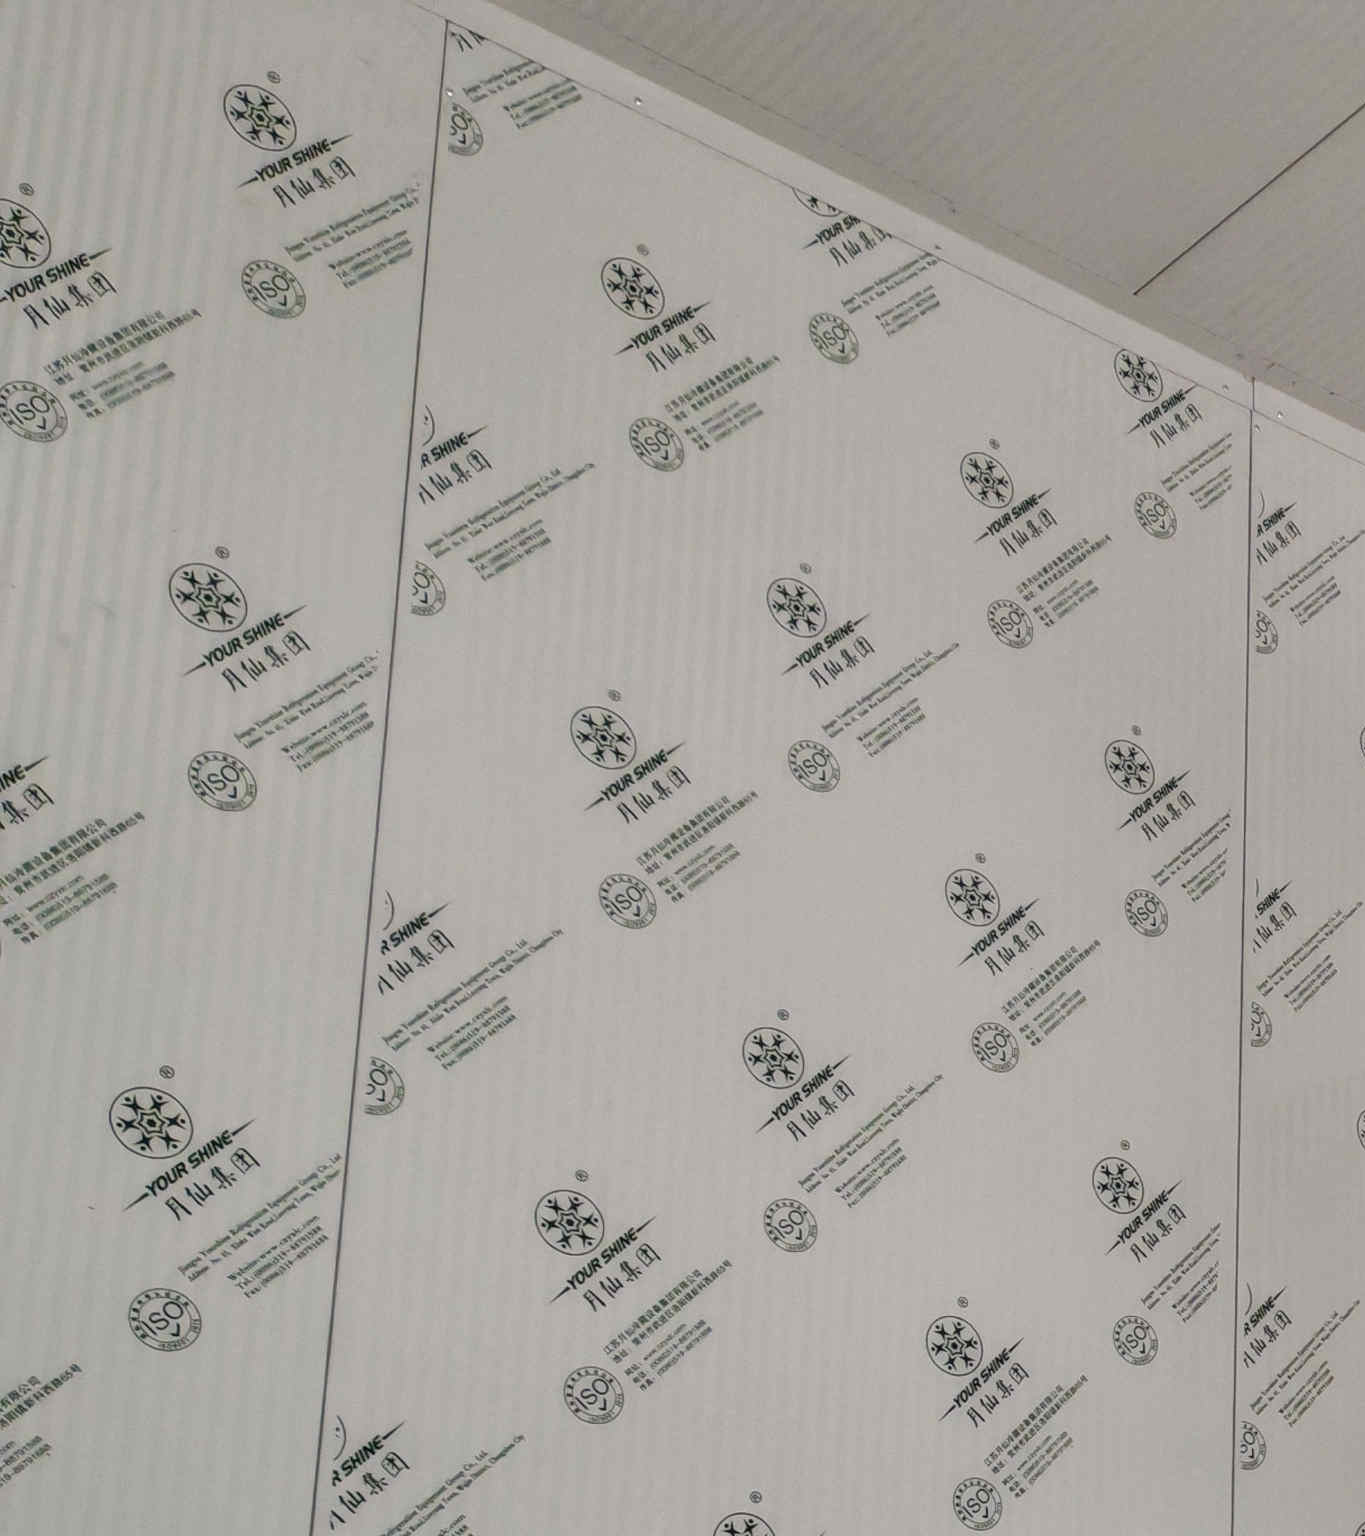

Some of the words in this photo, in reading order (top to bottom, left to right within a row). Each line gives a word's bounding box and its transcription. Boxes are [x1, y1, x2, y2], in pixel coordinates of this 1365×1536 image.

[254, 156, 292, 181] YOUR
[291, 139, 334, 165] SHINE
[2, 273, 45, 300] YOUR
[45, 253, 93, 282] SHINE
[249, 271, 293, 301] ISO
[630, 325, 662, 348] YOUR
[661, 307, 696, 332] SHINE
[5, 392, 54, 424] ISO
[1138, 406, 1162, 427] YOUR
[1160, 389, 1186, 412] SHINE
[430, 432, 470, 461] SHINE
[637, 428, 673, 455] ISO
[986, 512, 1012, 535] YOUR
[1011, 494, 1040, 519] SHINE
[1140, 501, 1167, 525] ISO
[203, 637, 243, 666] YOUR
[242, 613, 287, 645] SHINE
[993, 608, 1024, 634] ISO
[795, 641, 824, 666] YOUR
[823, 621, 856, 648] SHINE
[197, 762, 243, 795] ISO
[600, 772, 634, 800] YOUR
[633, 749, 669, 780] SHINE
[796, 749, 830, 778] ISO
[1129, 797, 1153, 821] YOUR
[1152, 777, 1179, 803] SHINE
[607, 883, 645, 914] ISO
[1131, 897, 1159, 924] ISO
[389, 912, 432, 947] SHINE
[971, 929, 998, 955] YOUR
[997, 905, 1027, 935] SHINE
[978, 1030, 1009, 1059] ISO
[771, 1091, 802, 1120] YOUR
[801, 1064, 835, 1097] SHINE
[145, 1161, 188, 1196] YOUR
[187, 1129, 235, 1168] SHINE
[771, 1206, 807, 1238] ISO
[1116, 1215, 1142, 1243] YOUR
[1141, 1190, 1169, 1221] SHINE
[566, 1256, 602, 1289] YOUR
[600, 1226, 639, 1263] SHINE
[138, 1297, 187, 1335] ISO
[1119, 1322, 1148, 1352] ISO
[572, 1375, 612, 1410] ISO
[952, 1377, 981, 1407] YOUR
[980, 1348, 1011, 1382] SHINE
[341, 1435, 385, 1476] SHINE
[960, 1485, 992, 1517] ISO
